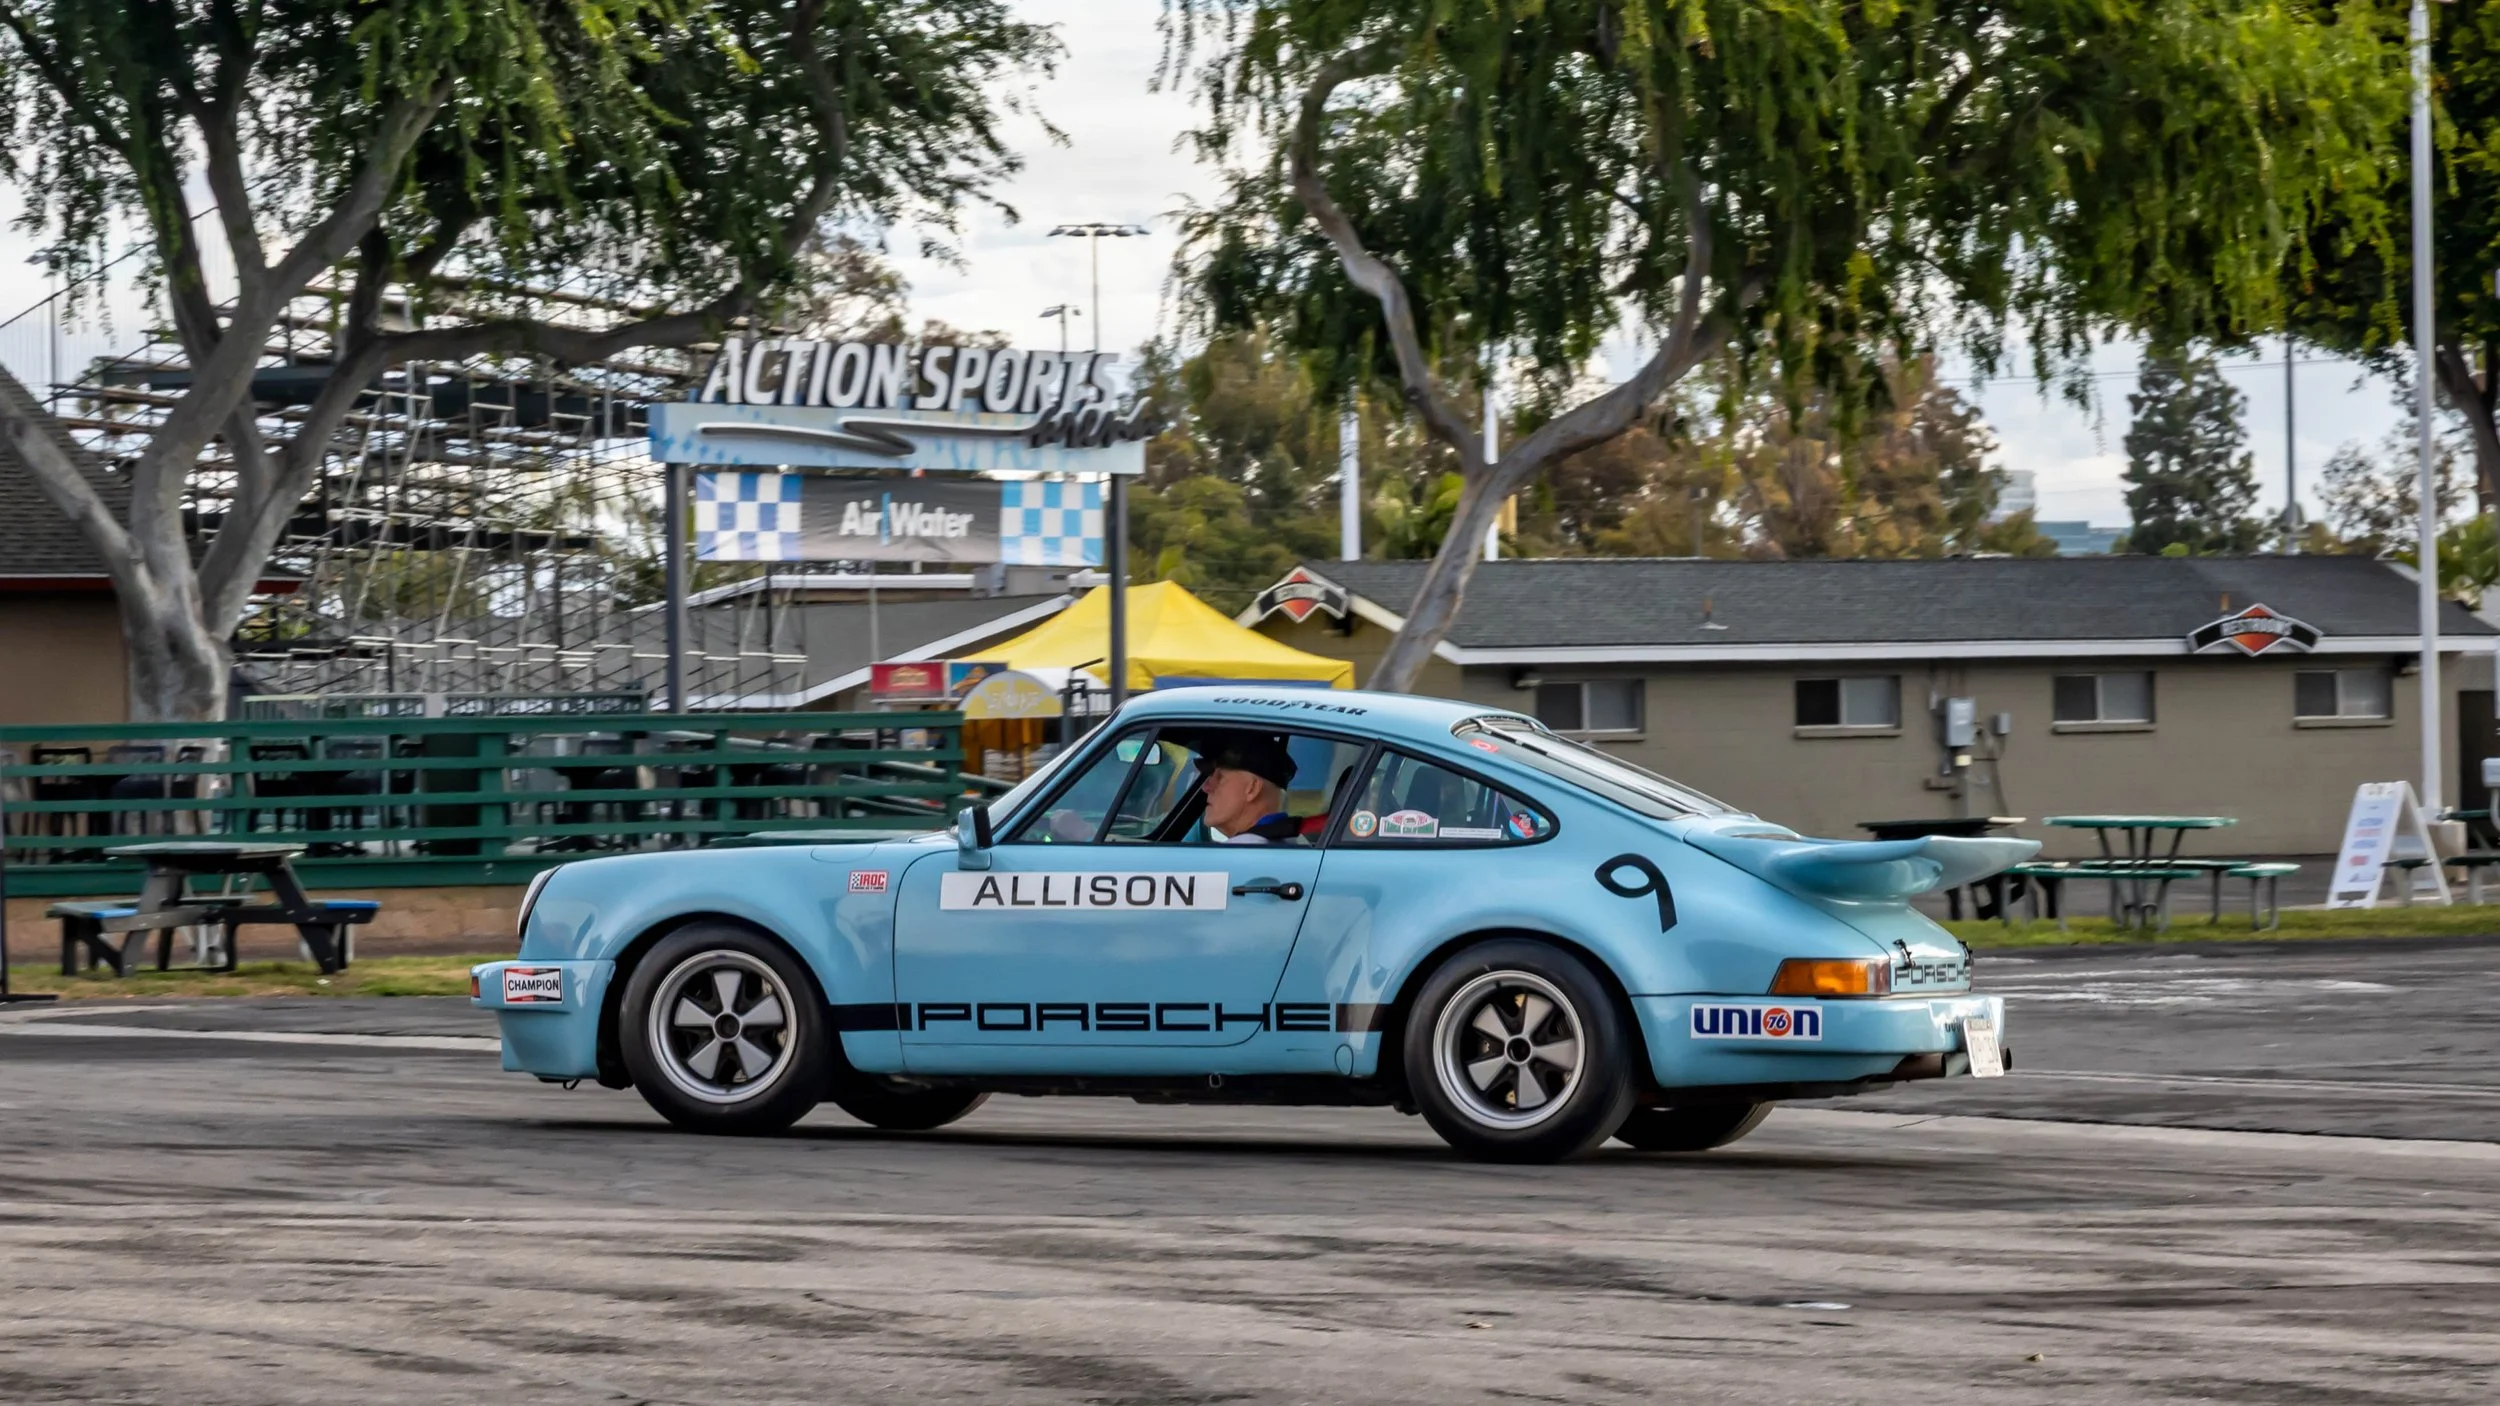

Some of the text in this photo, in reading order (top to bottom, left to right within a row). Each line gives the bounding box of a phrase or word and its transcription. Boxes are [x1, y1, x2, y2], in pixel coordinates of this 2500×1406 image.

[701, 337, 1120, 413] ACTION SPORTS
[839, 499, 975, 538] Air Water
[1213, 697, 1368, 716] GOODYEAR
[859, 873, 886, 887] IROC
[972, 875, 1196, 907] ALLISON
[1594, 852, 1678, 935] 9
[508, 979, 559, 991] CHAMPION
[1895, 963, 1970, 987] PORSCHE
[917, 1002, 1330, 1031] PORSCHE
